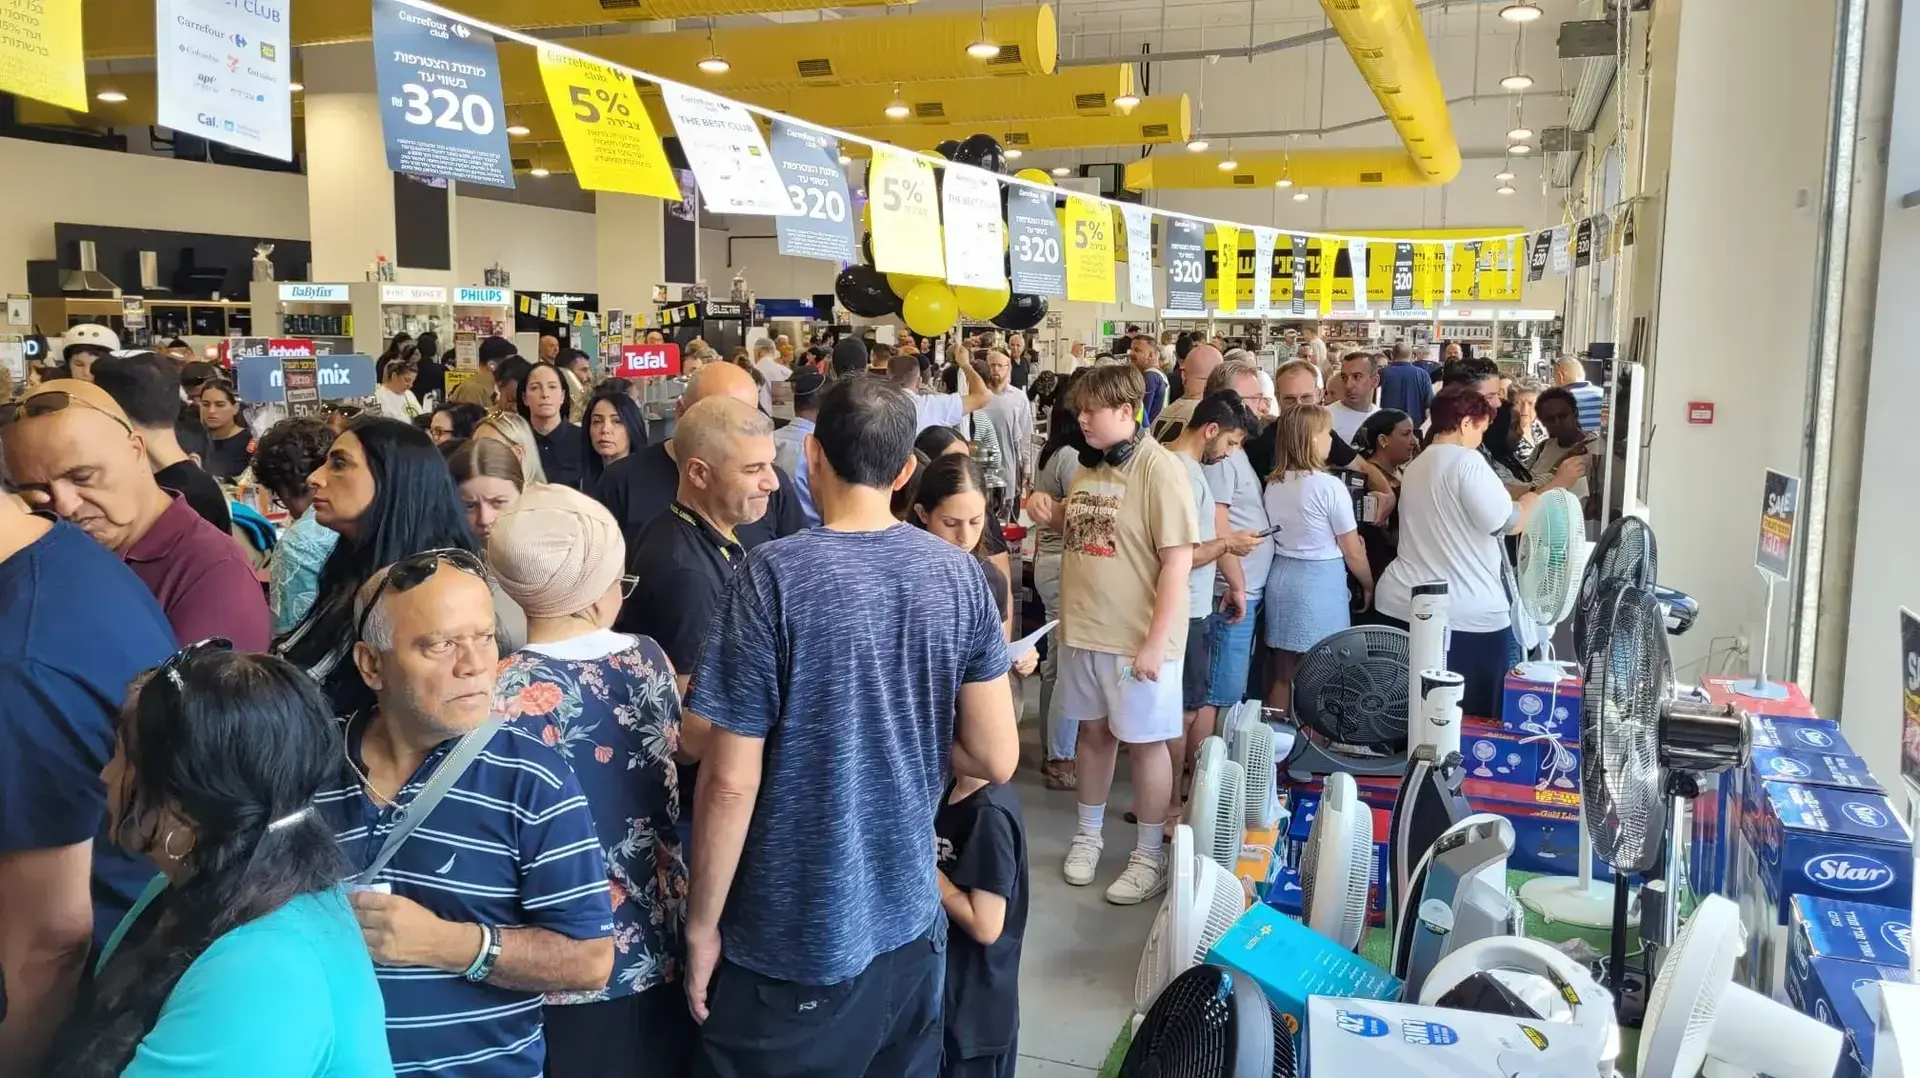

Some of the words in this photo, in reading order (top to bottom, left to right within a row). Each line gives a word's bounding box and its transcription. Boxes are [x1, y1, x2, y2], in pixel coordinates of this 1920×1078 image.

[177, 15, 226, 39] Carrefour
[398, 10, 448, 30] Carrefour
[429, 29, 449, 40] club
[394, 51, 451, 70] הצטרפות
[452, 61, 487, 77] מתנת
[547, 49, 602, 73] Carrefour
[418, 70, 435, 83] עד
[437, 73, 468, 89] בשווי
[584, 71, 607, 83] club
[402, 83, 494, 135] 320
[568, 85, 630, 124] 5%
[678, 115, 700, 127] THE
[701, 117, 726, 128] BEST
[786, 128, 817, 142] Carrefour
[788, 185, 846, 222] 320
[883, 177, 923, 212] 5%
[1075, 220, 1104, 249] 5%
[1019, 234, 1059, 264] 320
[1532, 252, 1547, 267] 320
[1173, 259, 1203, 284] 320
[1395, 272, 1412, 290] 320
[461, 289, 502, 302] PHILIPS
[625, 351, 667, 370] Tefal
[1767, 493, 1791, 518] SALE
[1540, 810, 1559, 819] Gold
[1815, 859, 1886, 882] Star
